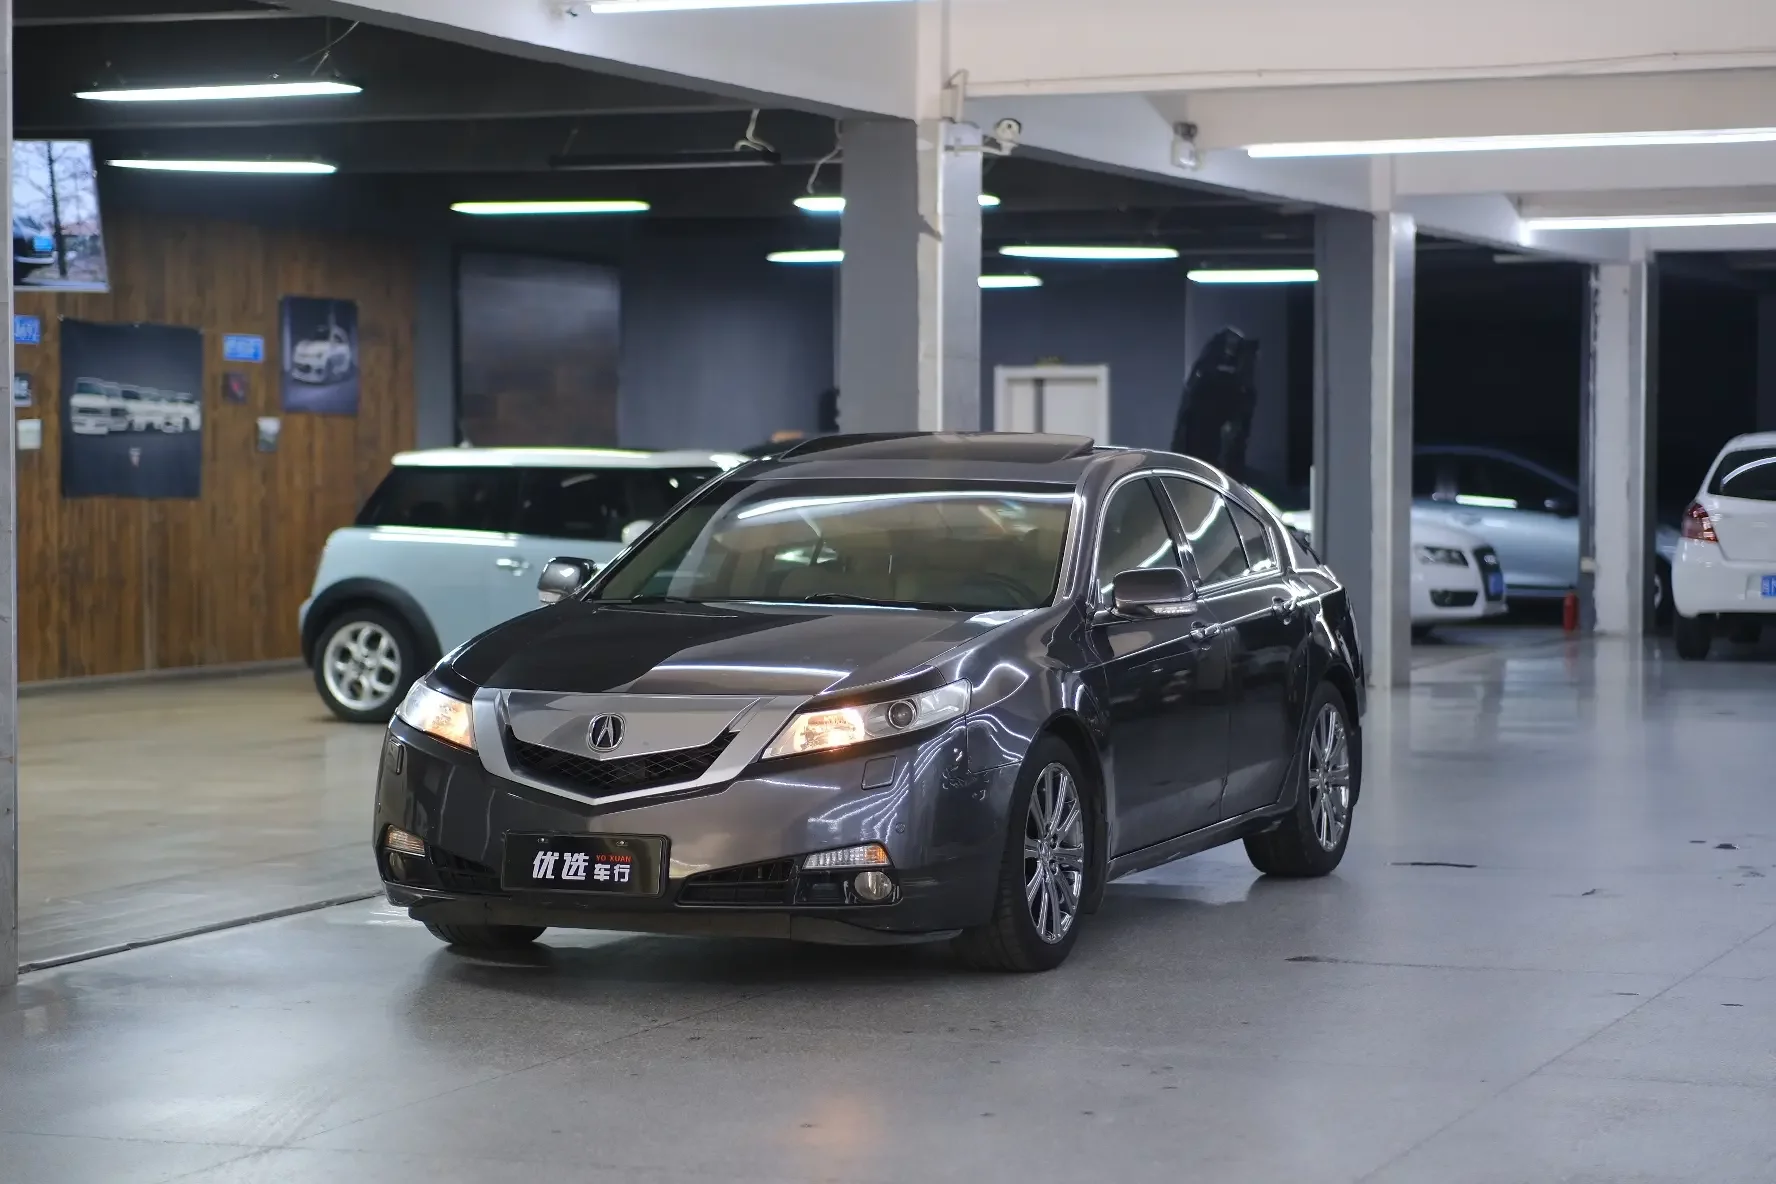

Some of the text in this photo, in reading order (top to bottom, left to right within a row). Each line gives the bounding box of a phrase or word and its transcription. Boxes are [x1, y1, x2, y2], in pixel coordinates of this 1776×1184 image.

[532, 851, 590, 880] 优选
[609, 855, 632, 863] XUAN
[593, 863, 631, 882] 车行
